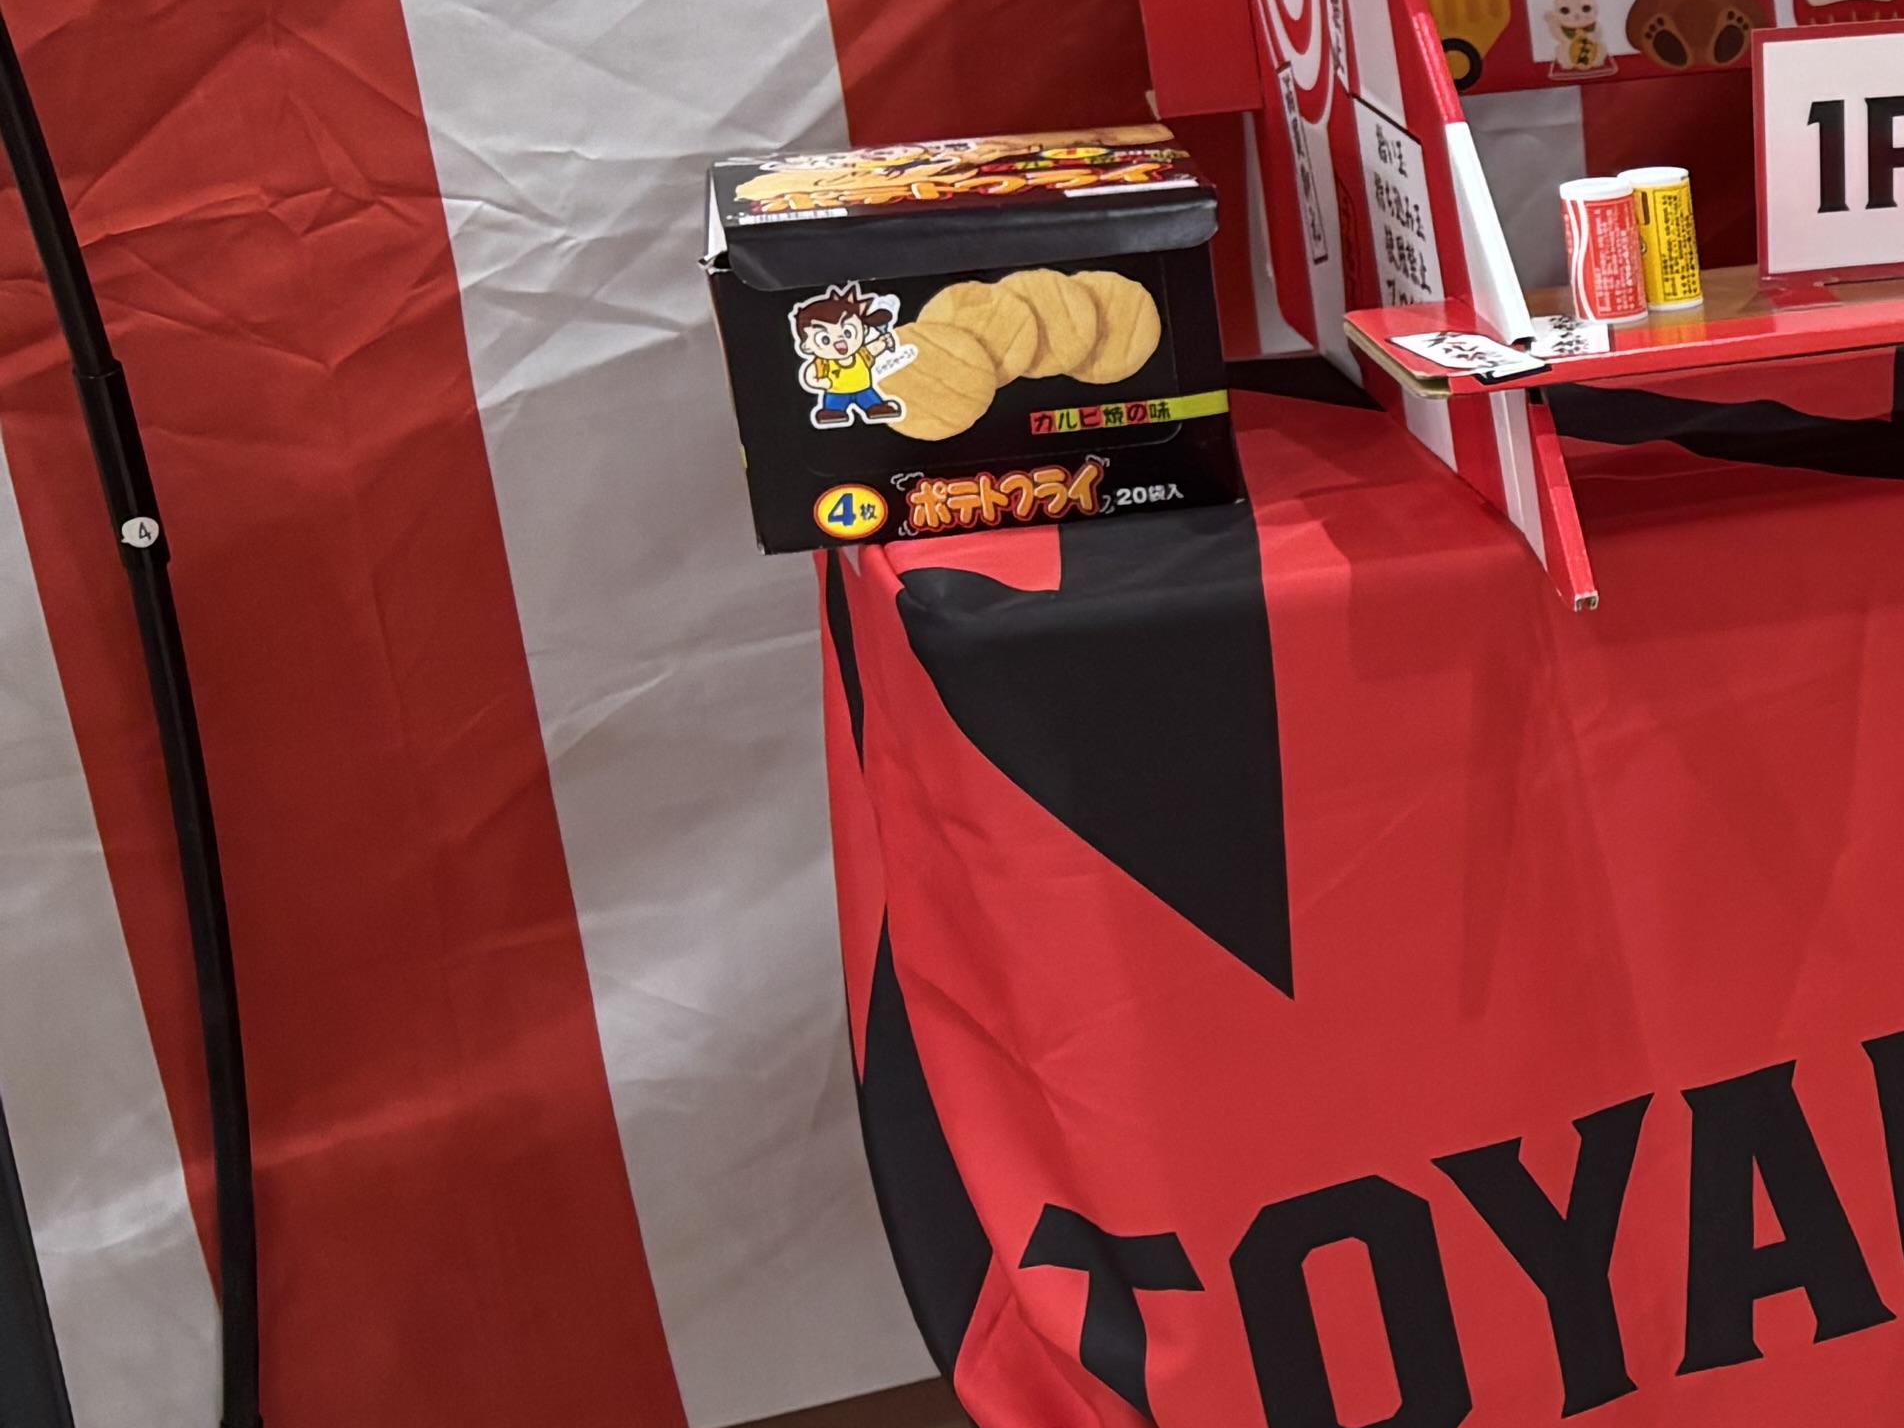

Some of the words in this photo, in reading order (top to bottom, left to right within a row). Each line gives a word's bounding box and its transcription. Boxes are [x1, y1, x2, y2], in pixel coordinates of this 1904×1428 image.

[909, 462, 1104, 529] ポテトフライ
